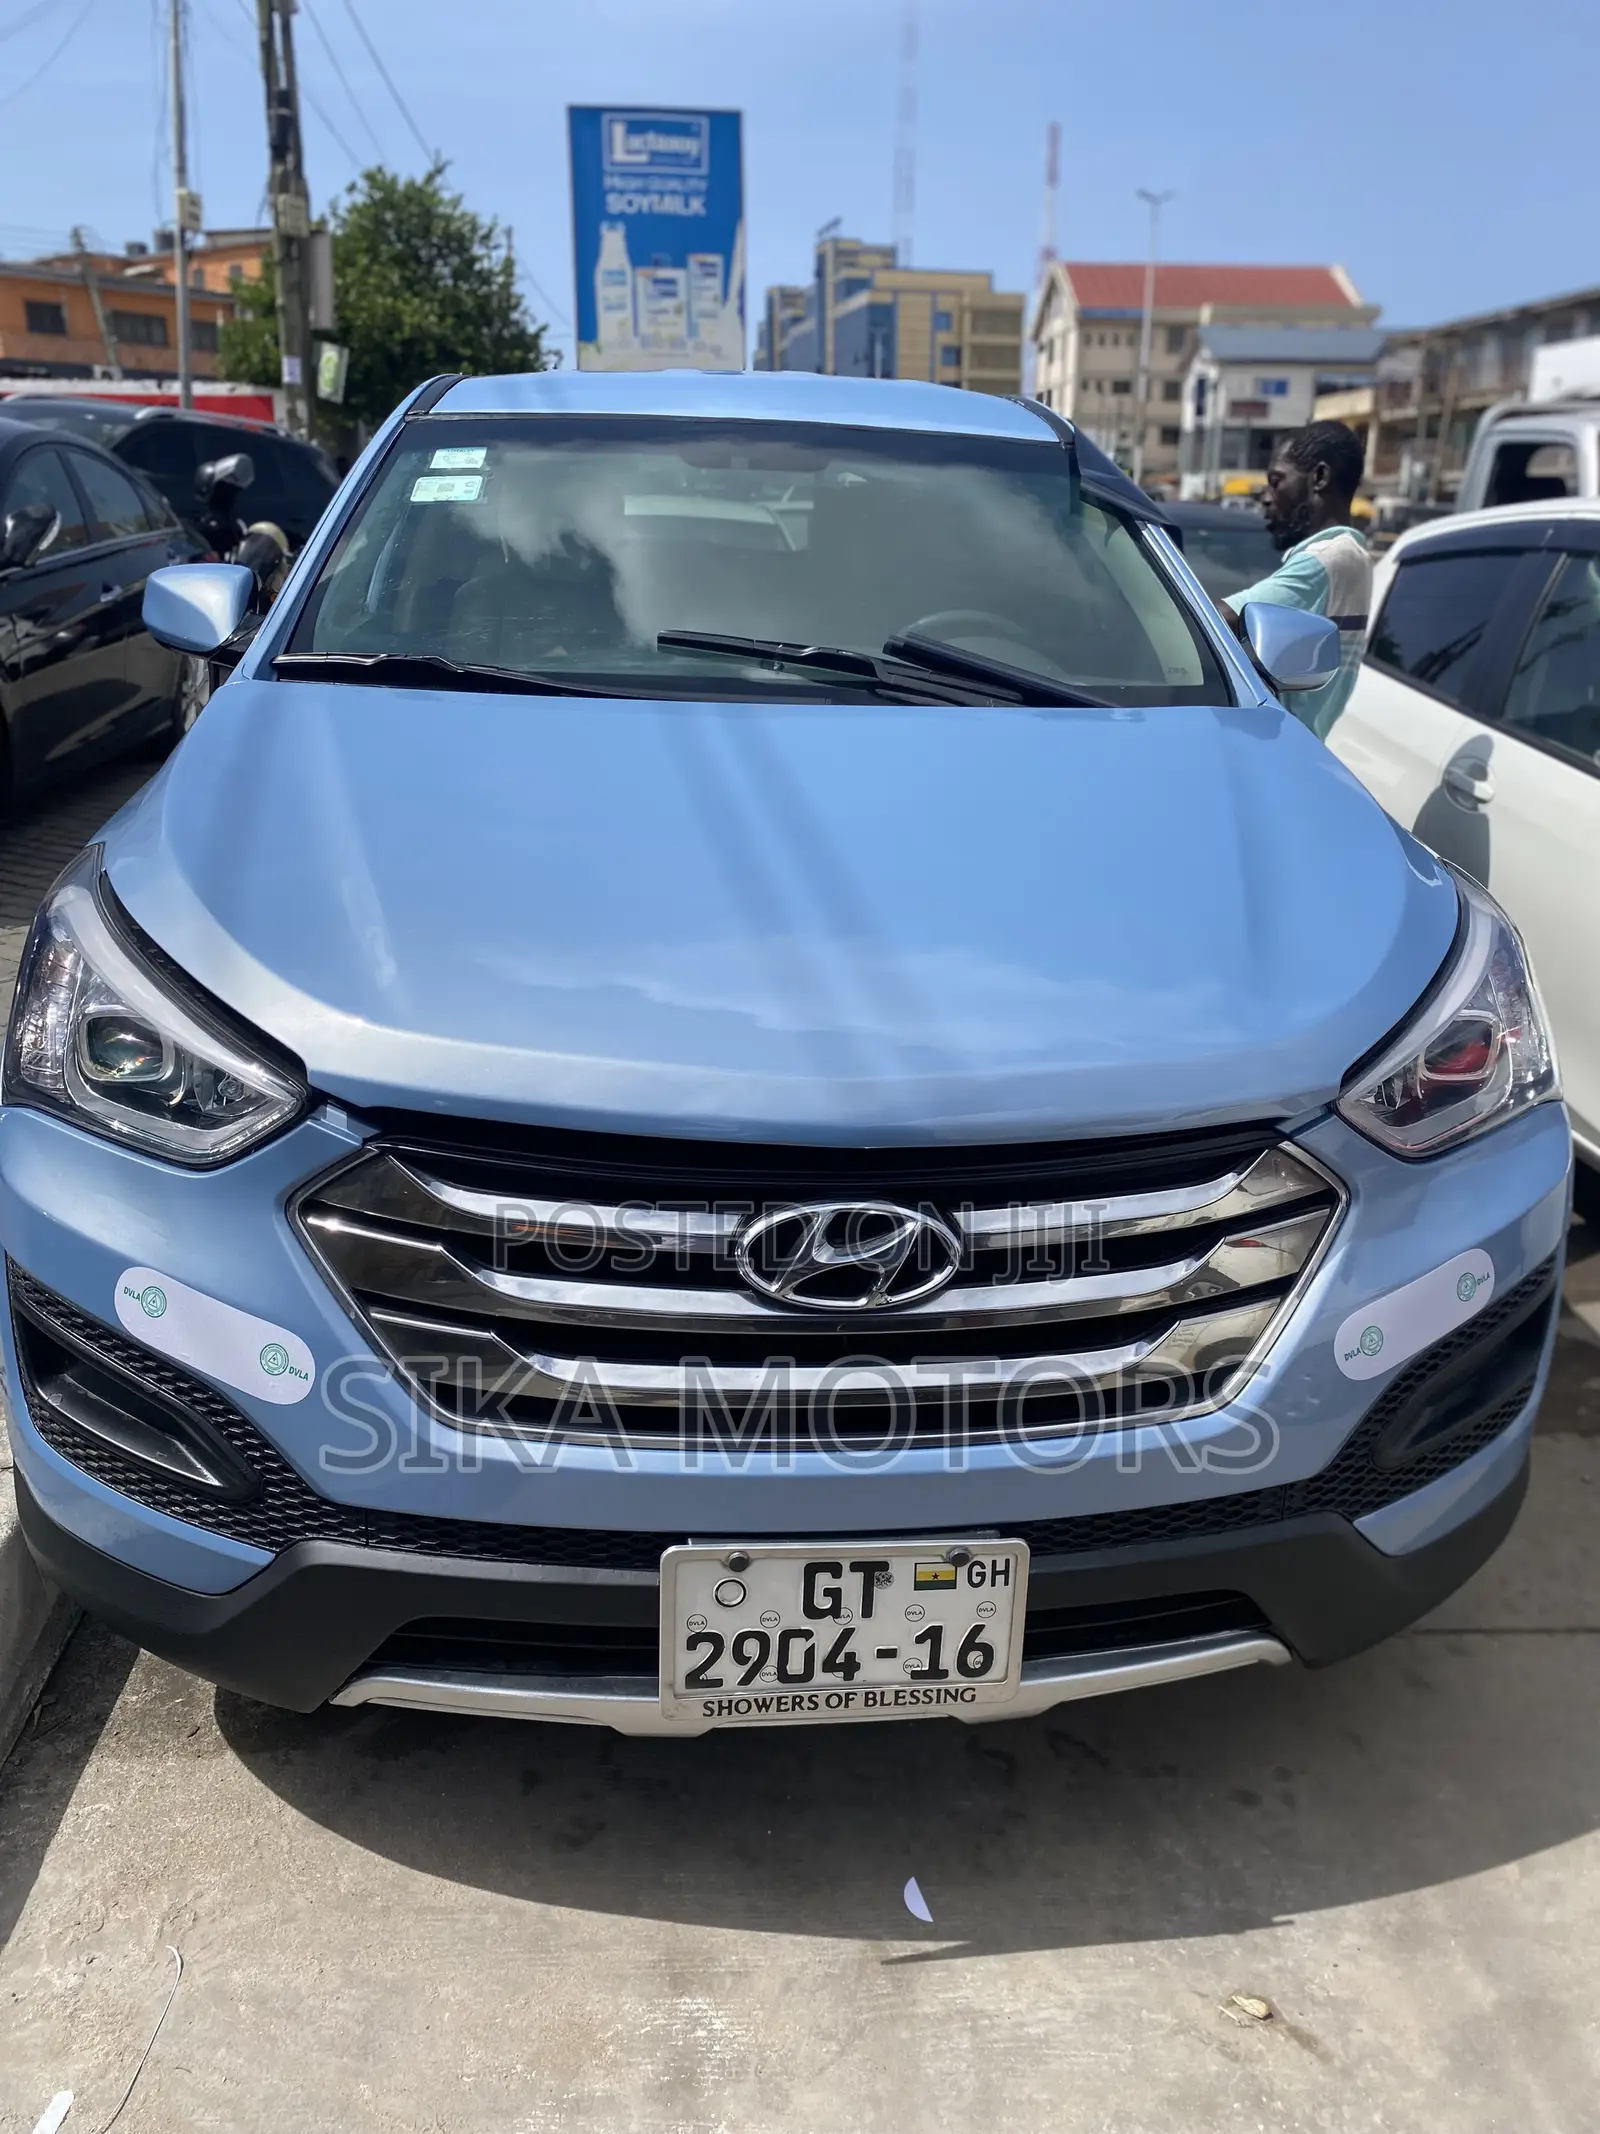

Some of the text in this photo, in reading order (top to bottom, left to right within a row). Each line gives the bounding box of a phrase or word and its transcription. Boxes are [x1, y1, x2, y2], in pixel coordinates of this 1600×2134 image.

[605, 191, 707, 216] SOYMILK
[123, 1286, 141, 1302] DVLA
[1344, 1347, 1362, 1362] DVLA
[288, 1366, 309, 1382] DVLA
[966, 1557, 1011, 1589] GH
[802, 1560, 890, 1620] GT
[684, 1623, 995, 1690] 2904-16
[702, 1687, 977, 1717] SHOWERS OF BLESSING
